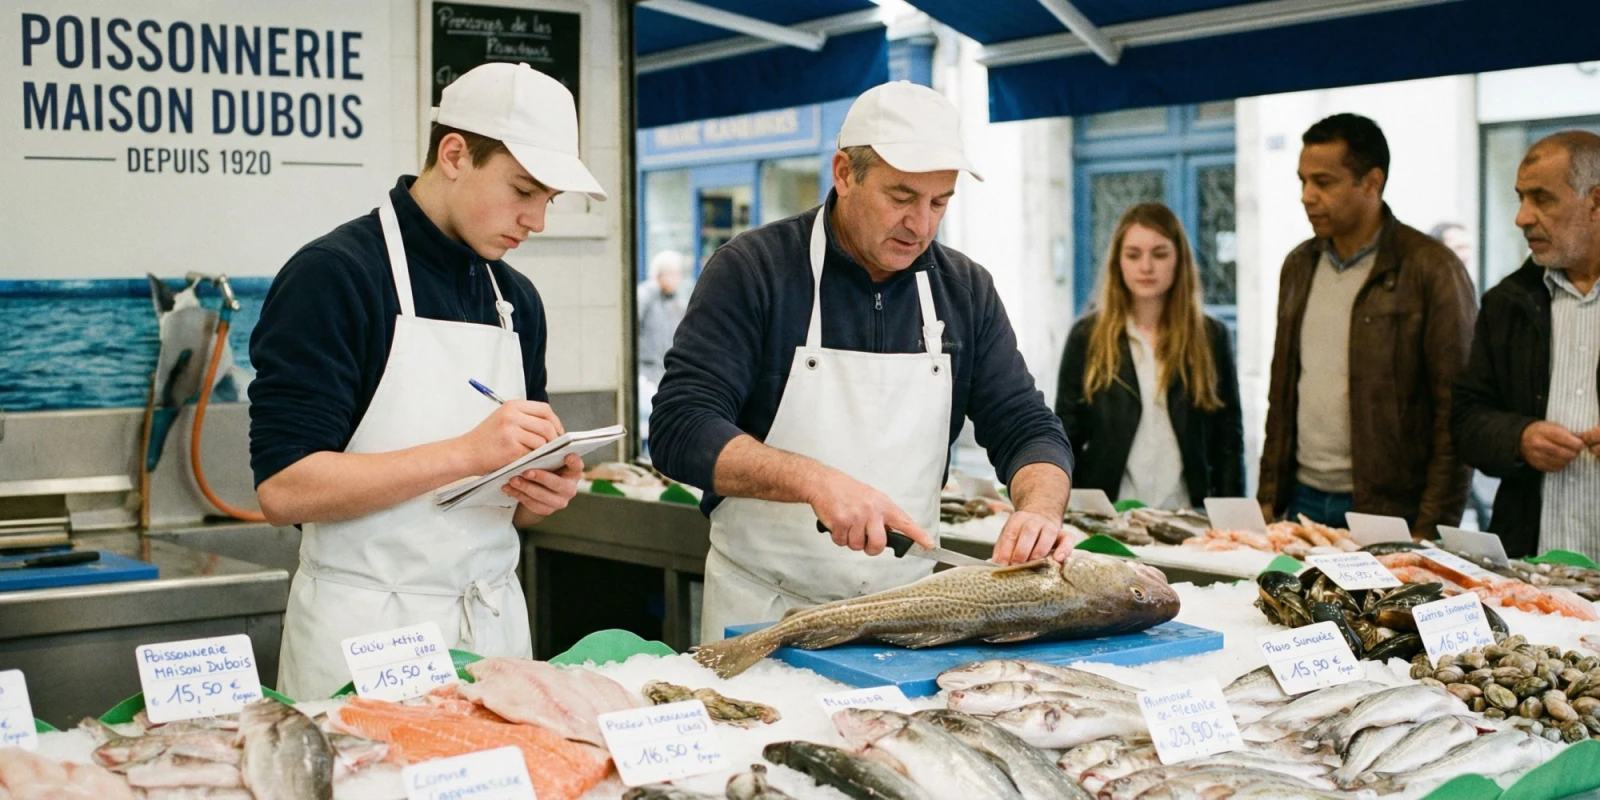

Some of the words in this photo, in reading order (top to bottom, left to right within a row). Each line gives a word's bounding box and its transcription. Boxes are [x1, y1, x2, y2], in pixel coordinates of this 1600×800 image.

[21, 13, 364, 81] POISSONNERIE
[23, 81, 193, 134] MAISON
[212, 89, 363, 139] DUBOIS
[127, 147, 209, 173] DEPUIS
[220, 150, 271, 175] 1920
[374, 665, 421, 689] 15,50
[1291, 659, 1330, 679] 15,90
[166, 681, 222, 704] 15,50
[1169, 721, 1214, 748] 23,90
